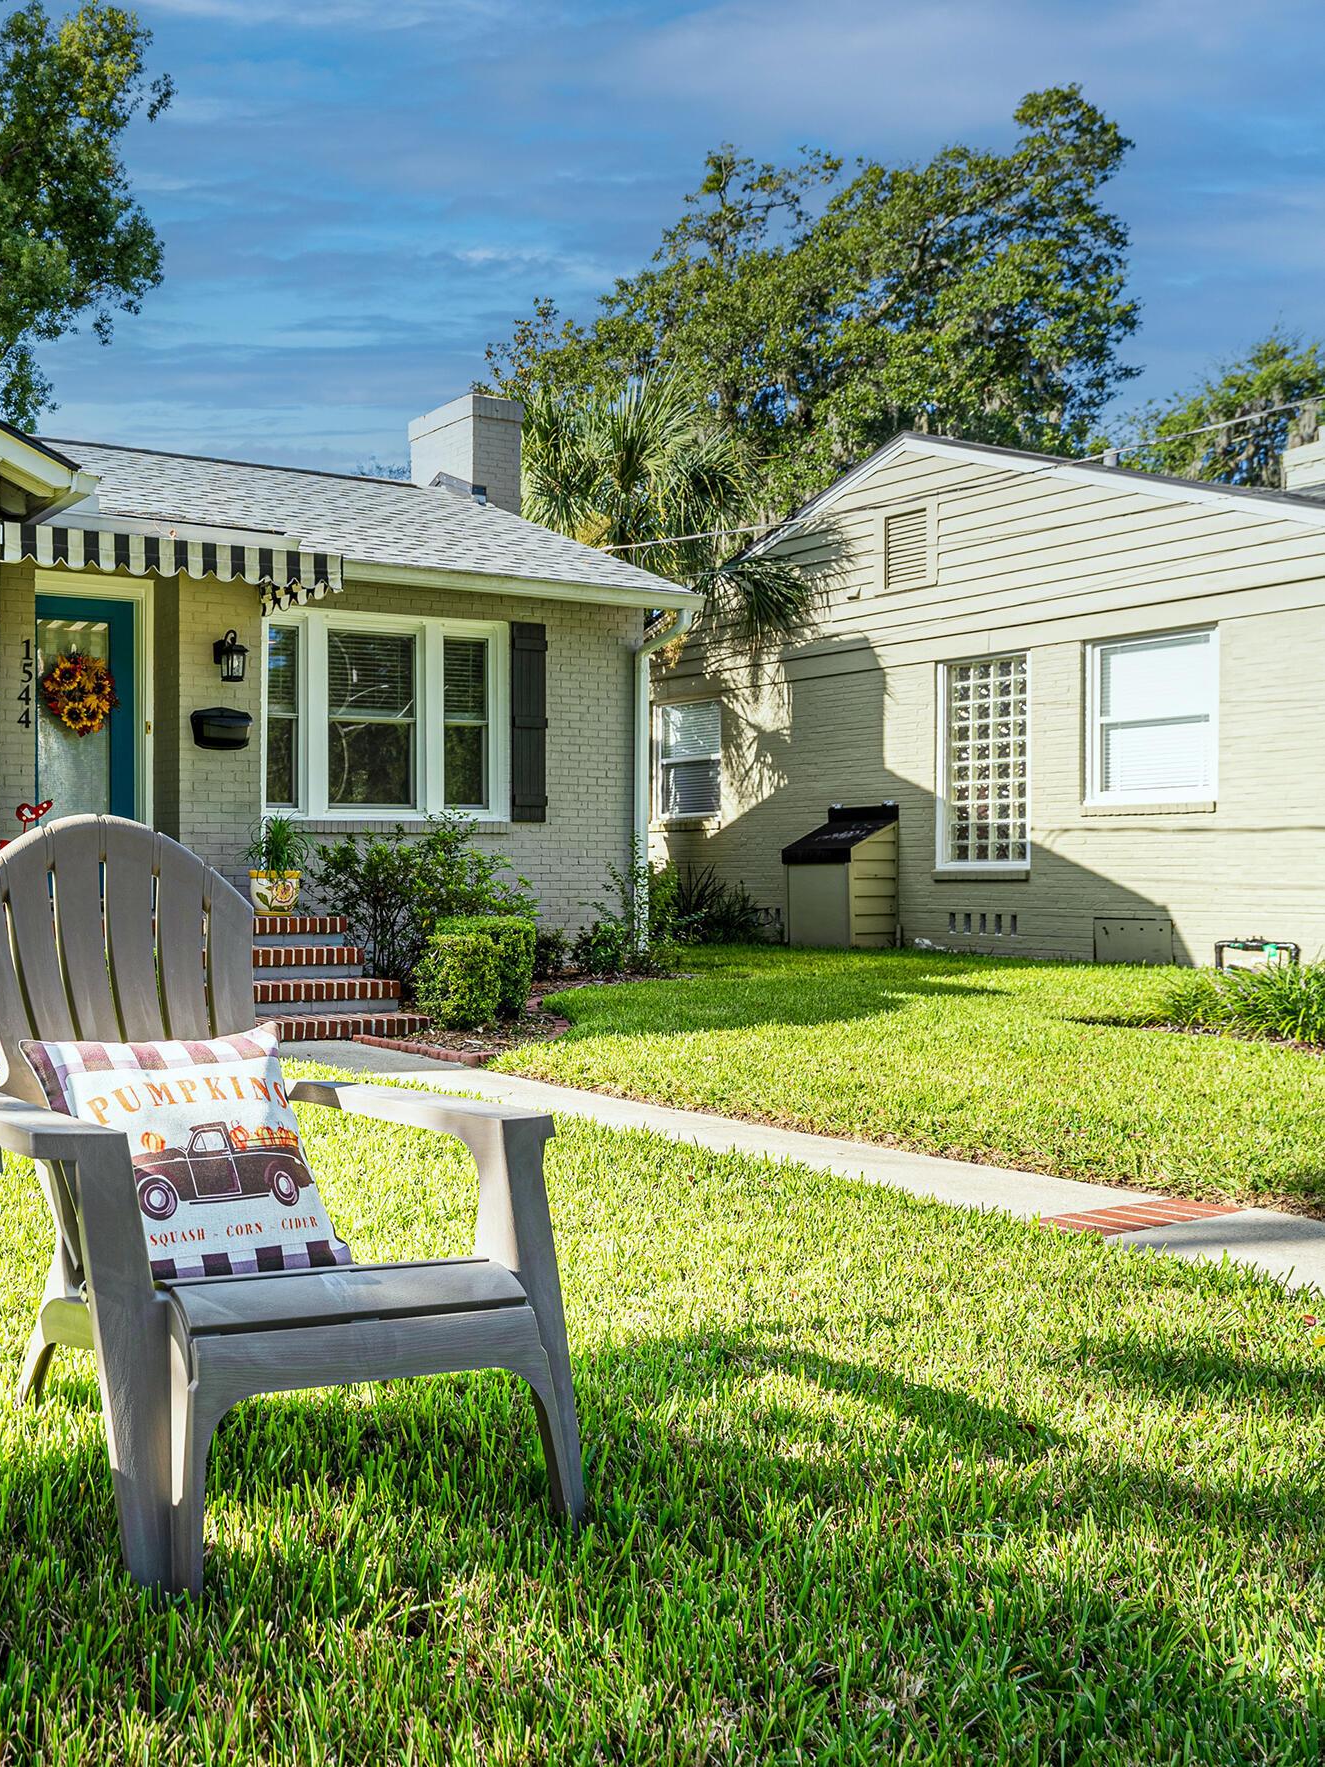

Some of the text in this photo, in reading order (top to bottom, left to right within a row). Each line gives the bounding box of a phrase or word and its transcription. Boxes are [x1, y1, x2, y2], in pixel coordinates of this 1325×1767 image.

[86, 1076, 287, 1125] PUMPKINS
[150, 1215, 318, 1247] SQUASH CORN CIDER
